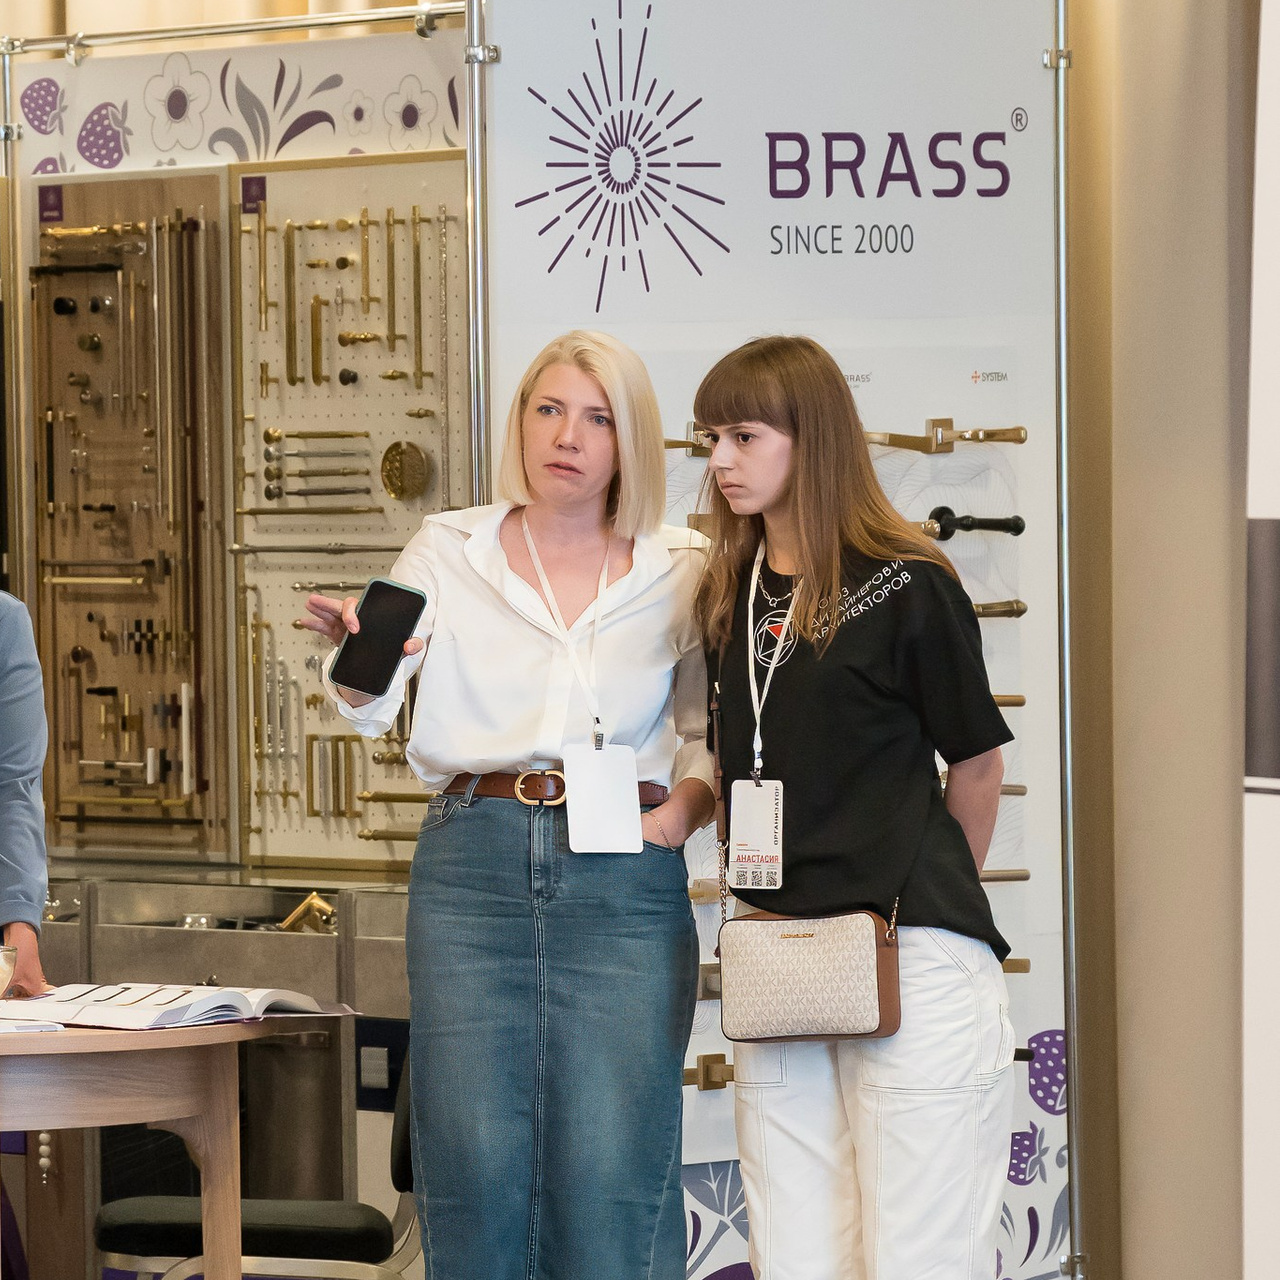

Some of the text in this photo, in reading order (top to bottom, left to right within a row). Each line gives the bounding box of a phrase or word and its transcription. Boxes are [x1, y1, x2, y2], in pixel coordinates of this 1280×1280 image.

[770, 224, 914, 254] SINCE 2000
[736, 854, 779, 864] АНАСТАСИЯ
